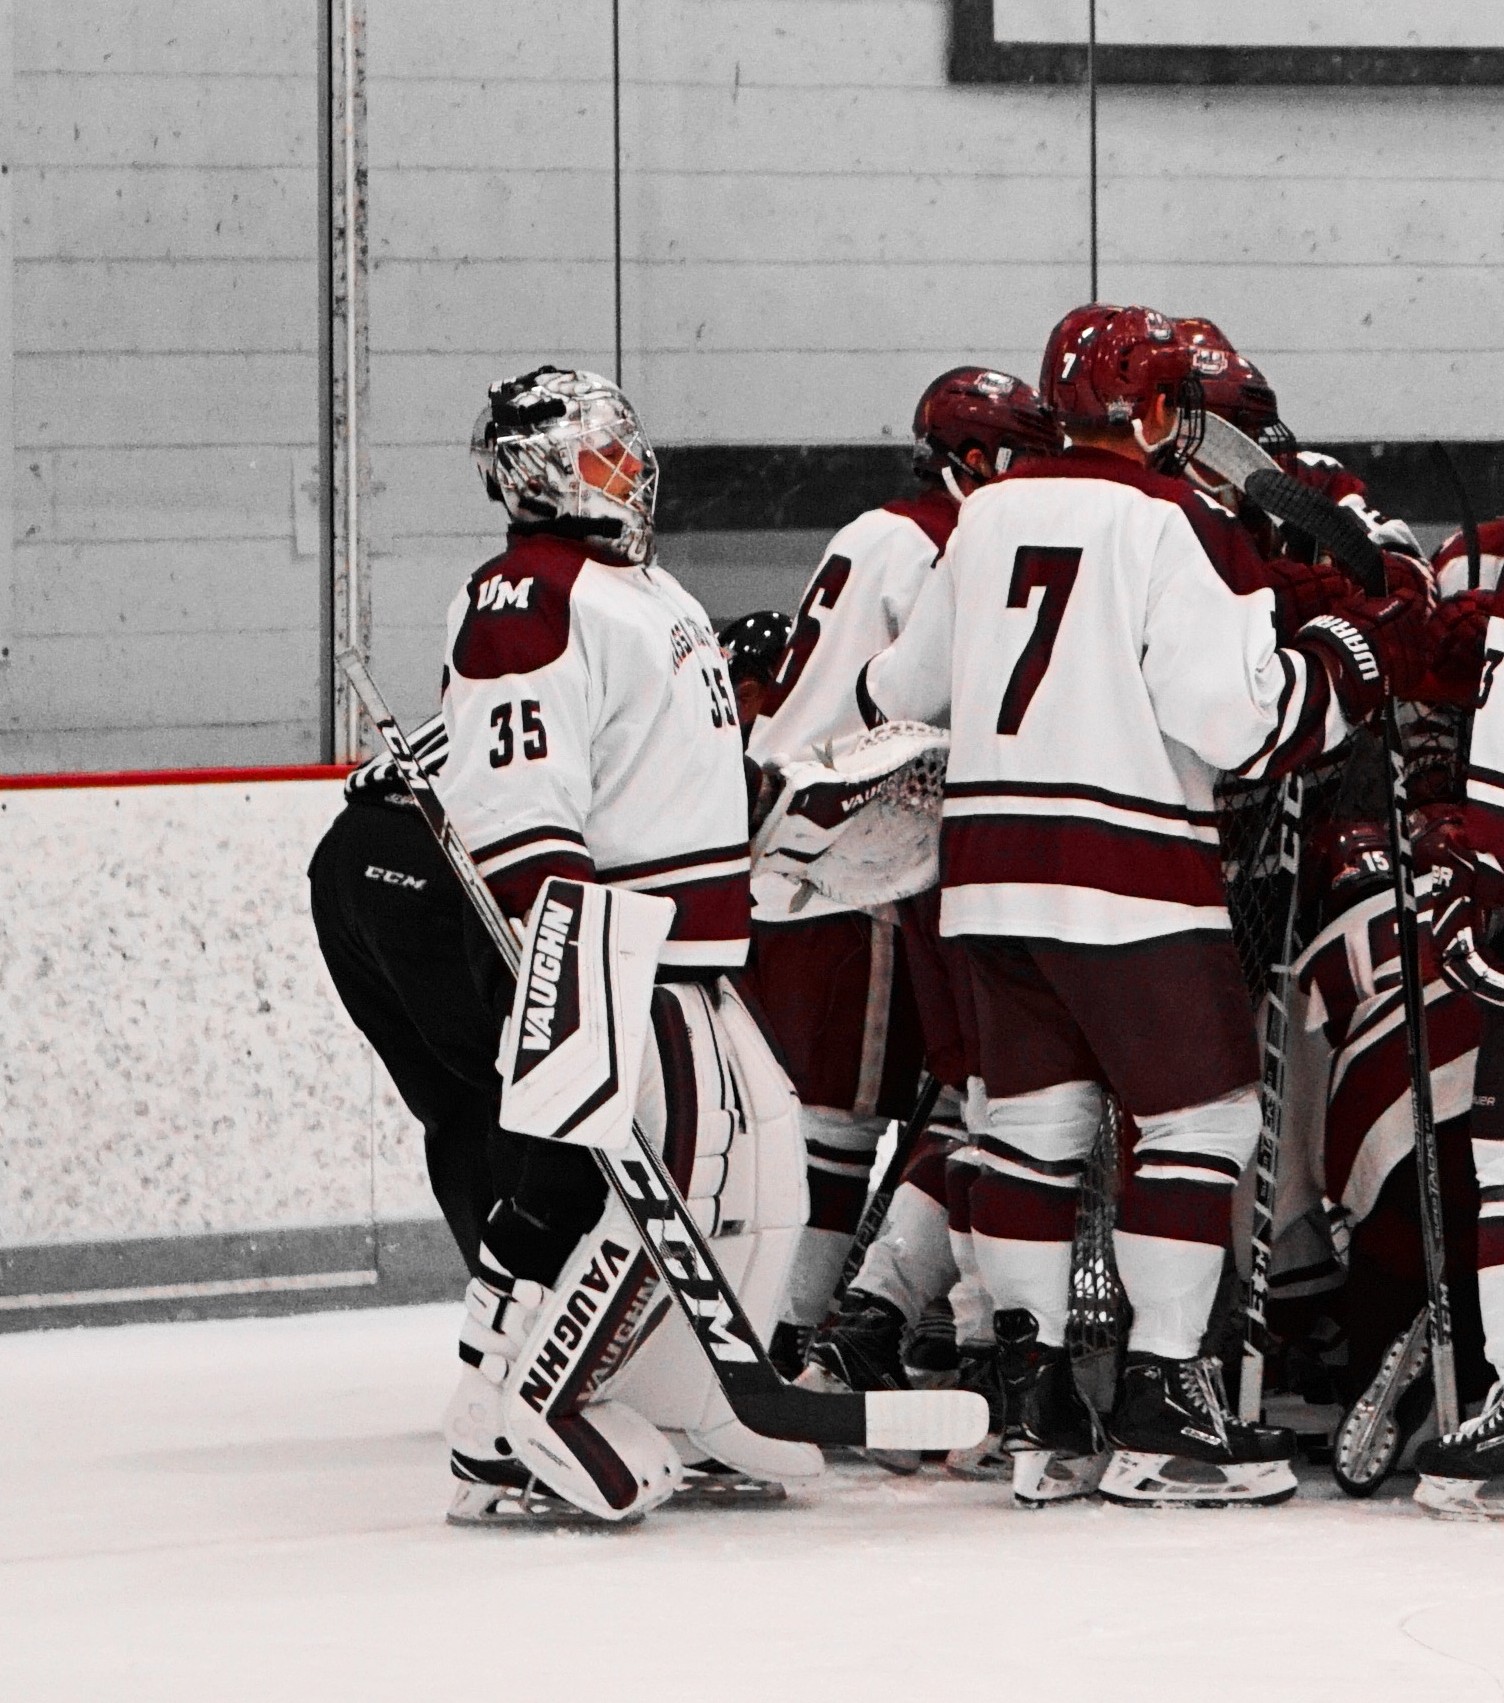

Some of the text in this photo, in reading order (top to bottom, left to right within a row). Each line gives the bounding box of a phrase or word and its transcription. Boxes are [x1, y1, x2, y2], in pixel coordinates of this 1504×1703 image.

[1061, 352, 1076, 379] 7
[476, 573, 534, 611] UM
[996, 545, 1083, 735] 7
[702, 667, 736, 728] 35
[490, 700, 547, 768] 35
[365, 865, 427, 890] CCM
[1362, 850, 1389, 872] 15
[521, 900, 575, 1051] VAUGHN
[612, 1150, 758, 1365] CCM
[517, 1238, 632, 1417] VAUGHN
[576, 1276, 661, 1402] VAUGHN
